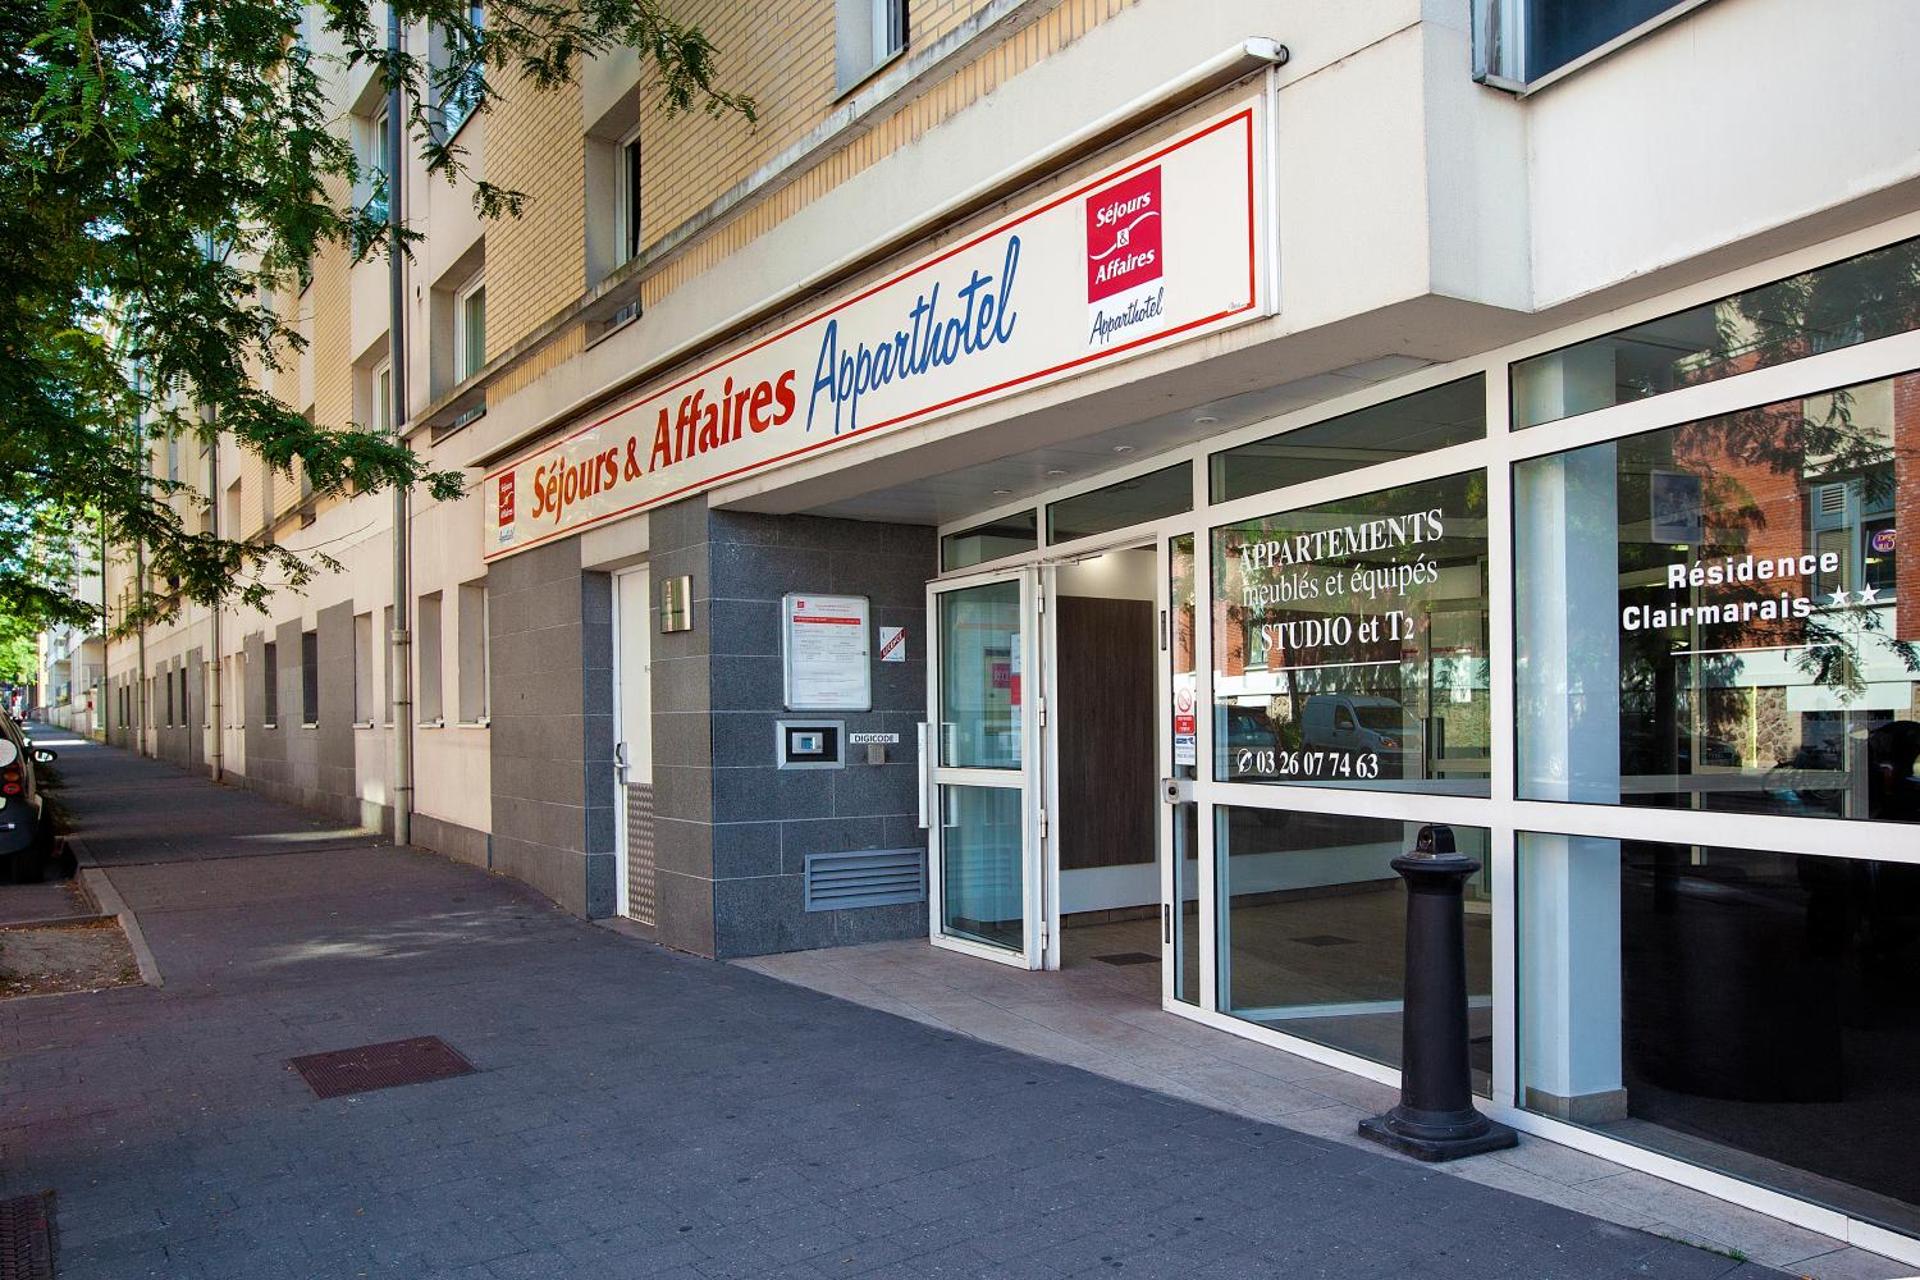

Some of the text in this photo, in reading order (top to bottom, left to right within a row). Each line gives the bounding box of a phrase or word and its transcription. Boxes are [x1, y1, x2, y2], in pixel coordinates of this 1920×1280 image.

[1096, 191, 1151, 228] Séjours
[1096, 249, 1155, 284] Affaires
[1089, 286, 1164, 345] Apparthotel
[532, 235, 1021, 525] Séjours & Affaires Apparthotel
[1240, 508, 1444, 573] APPARTEMENTS
[1243, 553, 1439, 607] meublés et équipés
[1668, 551, 1839, 590] Résidence
[1623, 592, 1811, 631] Clairmarais
[1261, 616, 1352, 652] STUDIO
[1358, 620, 1379, 644] et
[1256, 750, 1378, 779] 03 26 07 74 63
